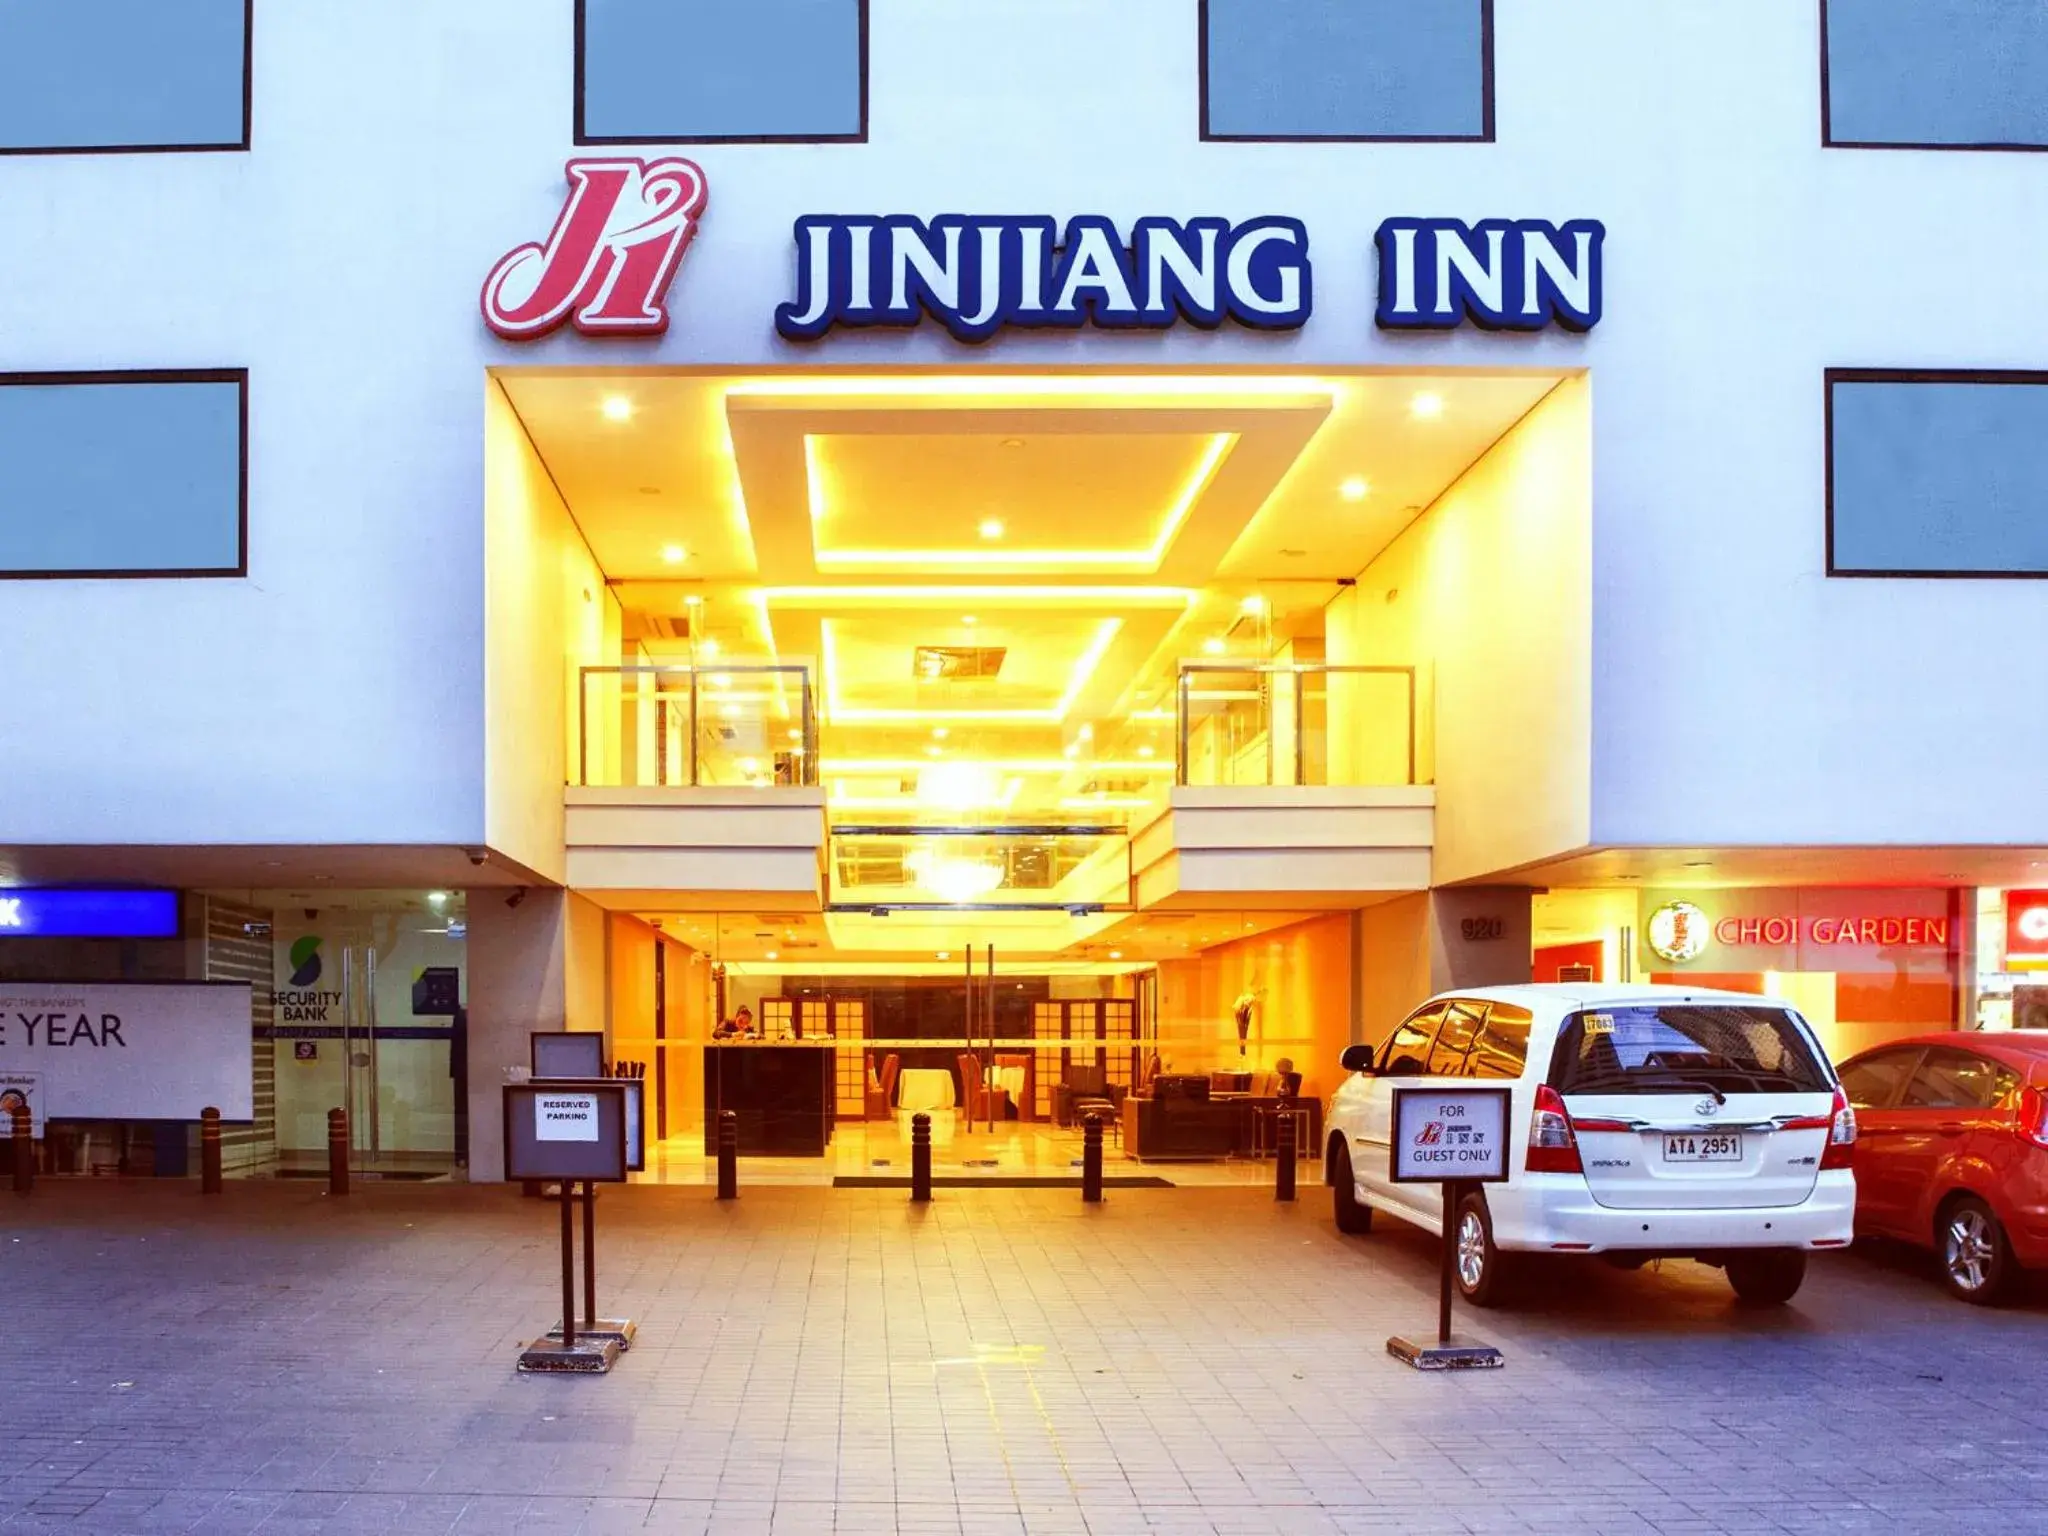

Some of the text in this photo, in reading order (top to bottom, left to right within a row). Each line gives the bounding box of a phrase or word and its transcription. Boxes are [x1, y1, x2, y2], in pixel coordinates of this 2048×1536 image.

[786, 223, 1594, 328] JINJIANG INN
[1715, 917, 1800, 945] CHOI
[1811, 917, 1948, 945] GARDEN
[270, 991, 342, 1007] SECURITY
[283, 1006, 328, 1022] BANK
[16, 1012, 127, 1047] YEAR
[543, 1101, 591, 1109] RESERVED
[1440, 1105, 1465, 1117] FOR
[546, 1113, 588, 1121] PARKING
[1669, 1138, 1737, 1155] ATA 2951
[1413, 1150, 1492, 1162] GUEST ONLY
